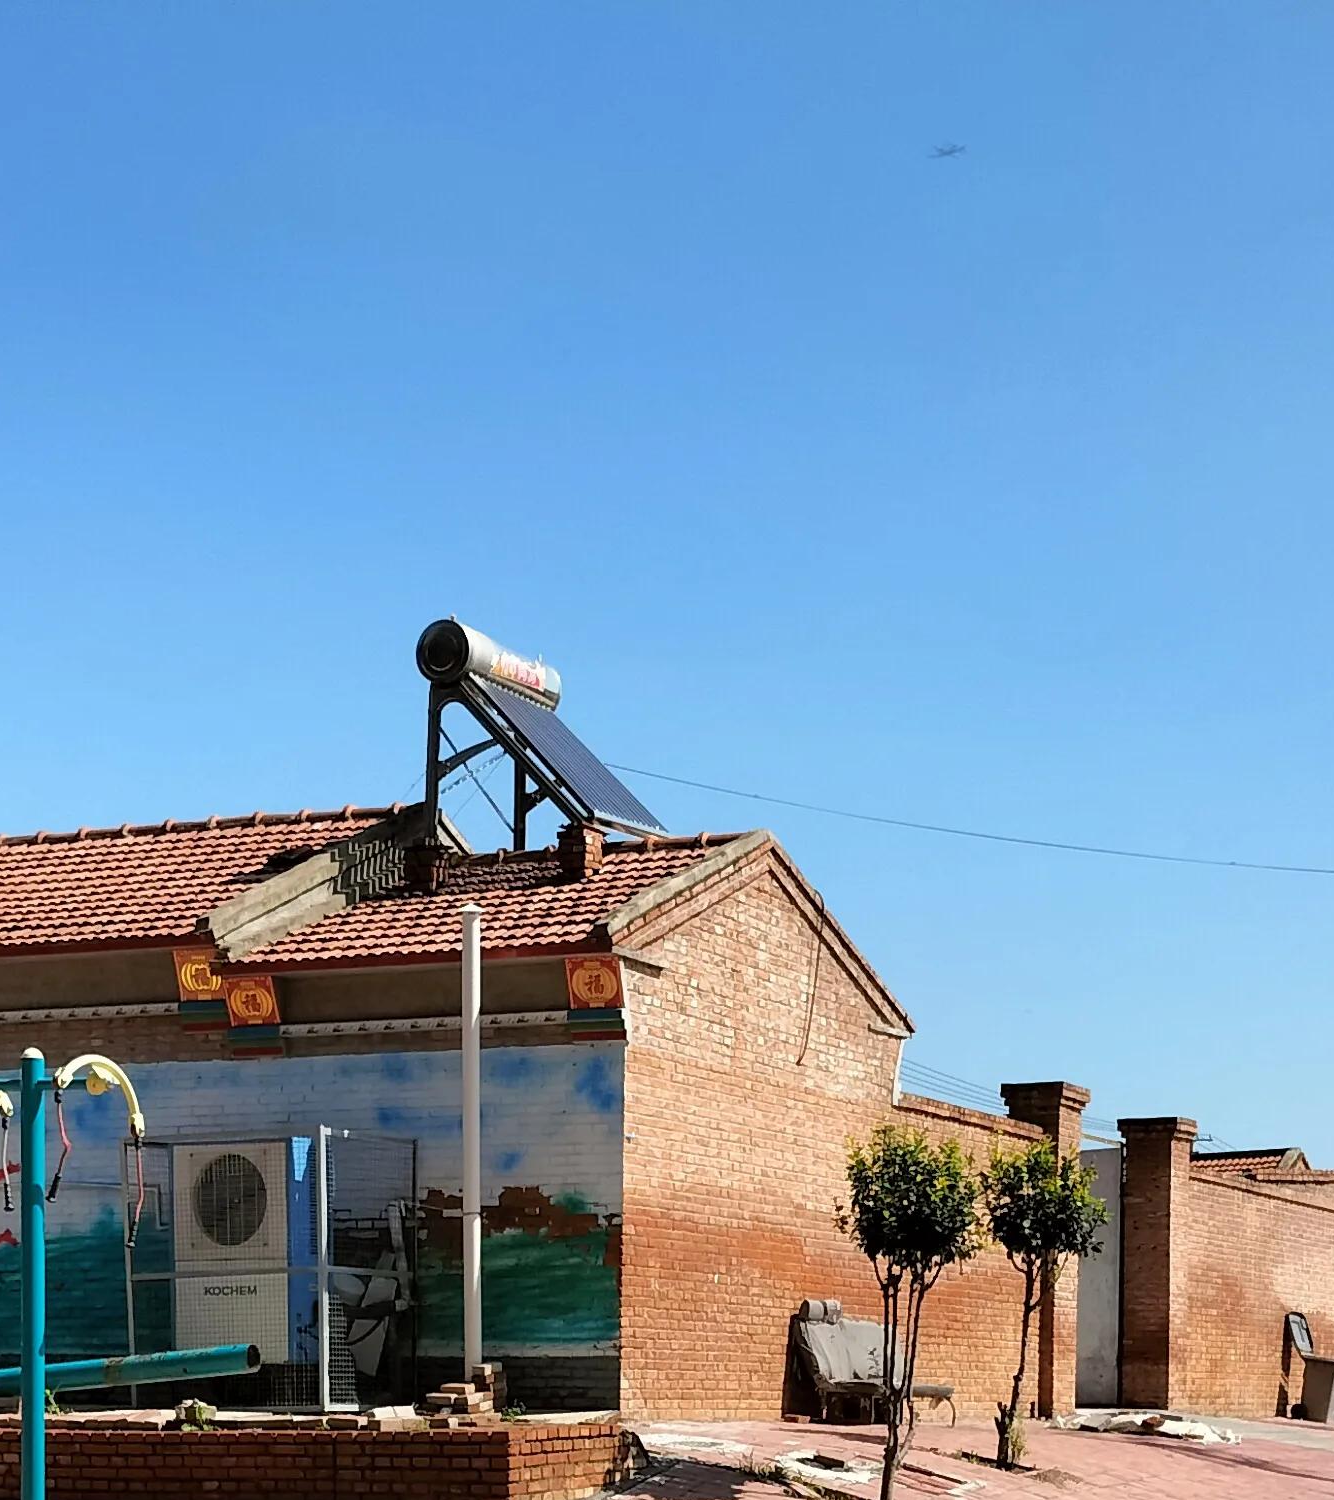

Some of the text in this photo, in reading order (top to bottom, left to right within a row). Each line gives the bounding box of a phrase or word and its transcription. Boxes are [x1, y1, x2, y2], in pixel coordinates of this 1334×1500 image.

[584, 973, 605, 995] 福
[241, 993, 261, 1013] 福
[204, 1285, 257, 1296] KOCHEM
